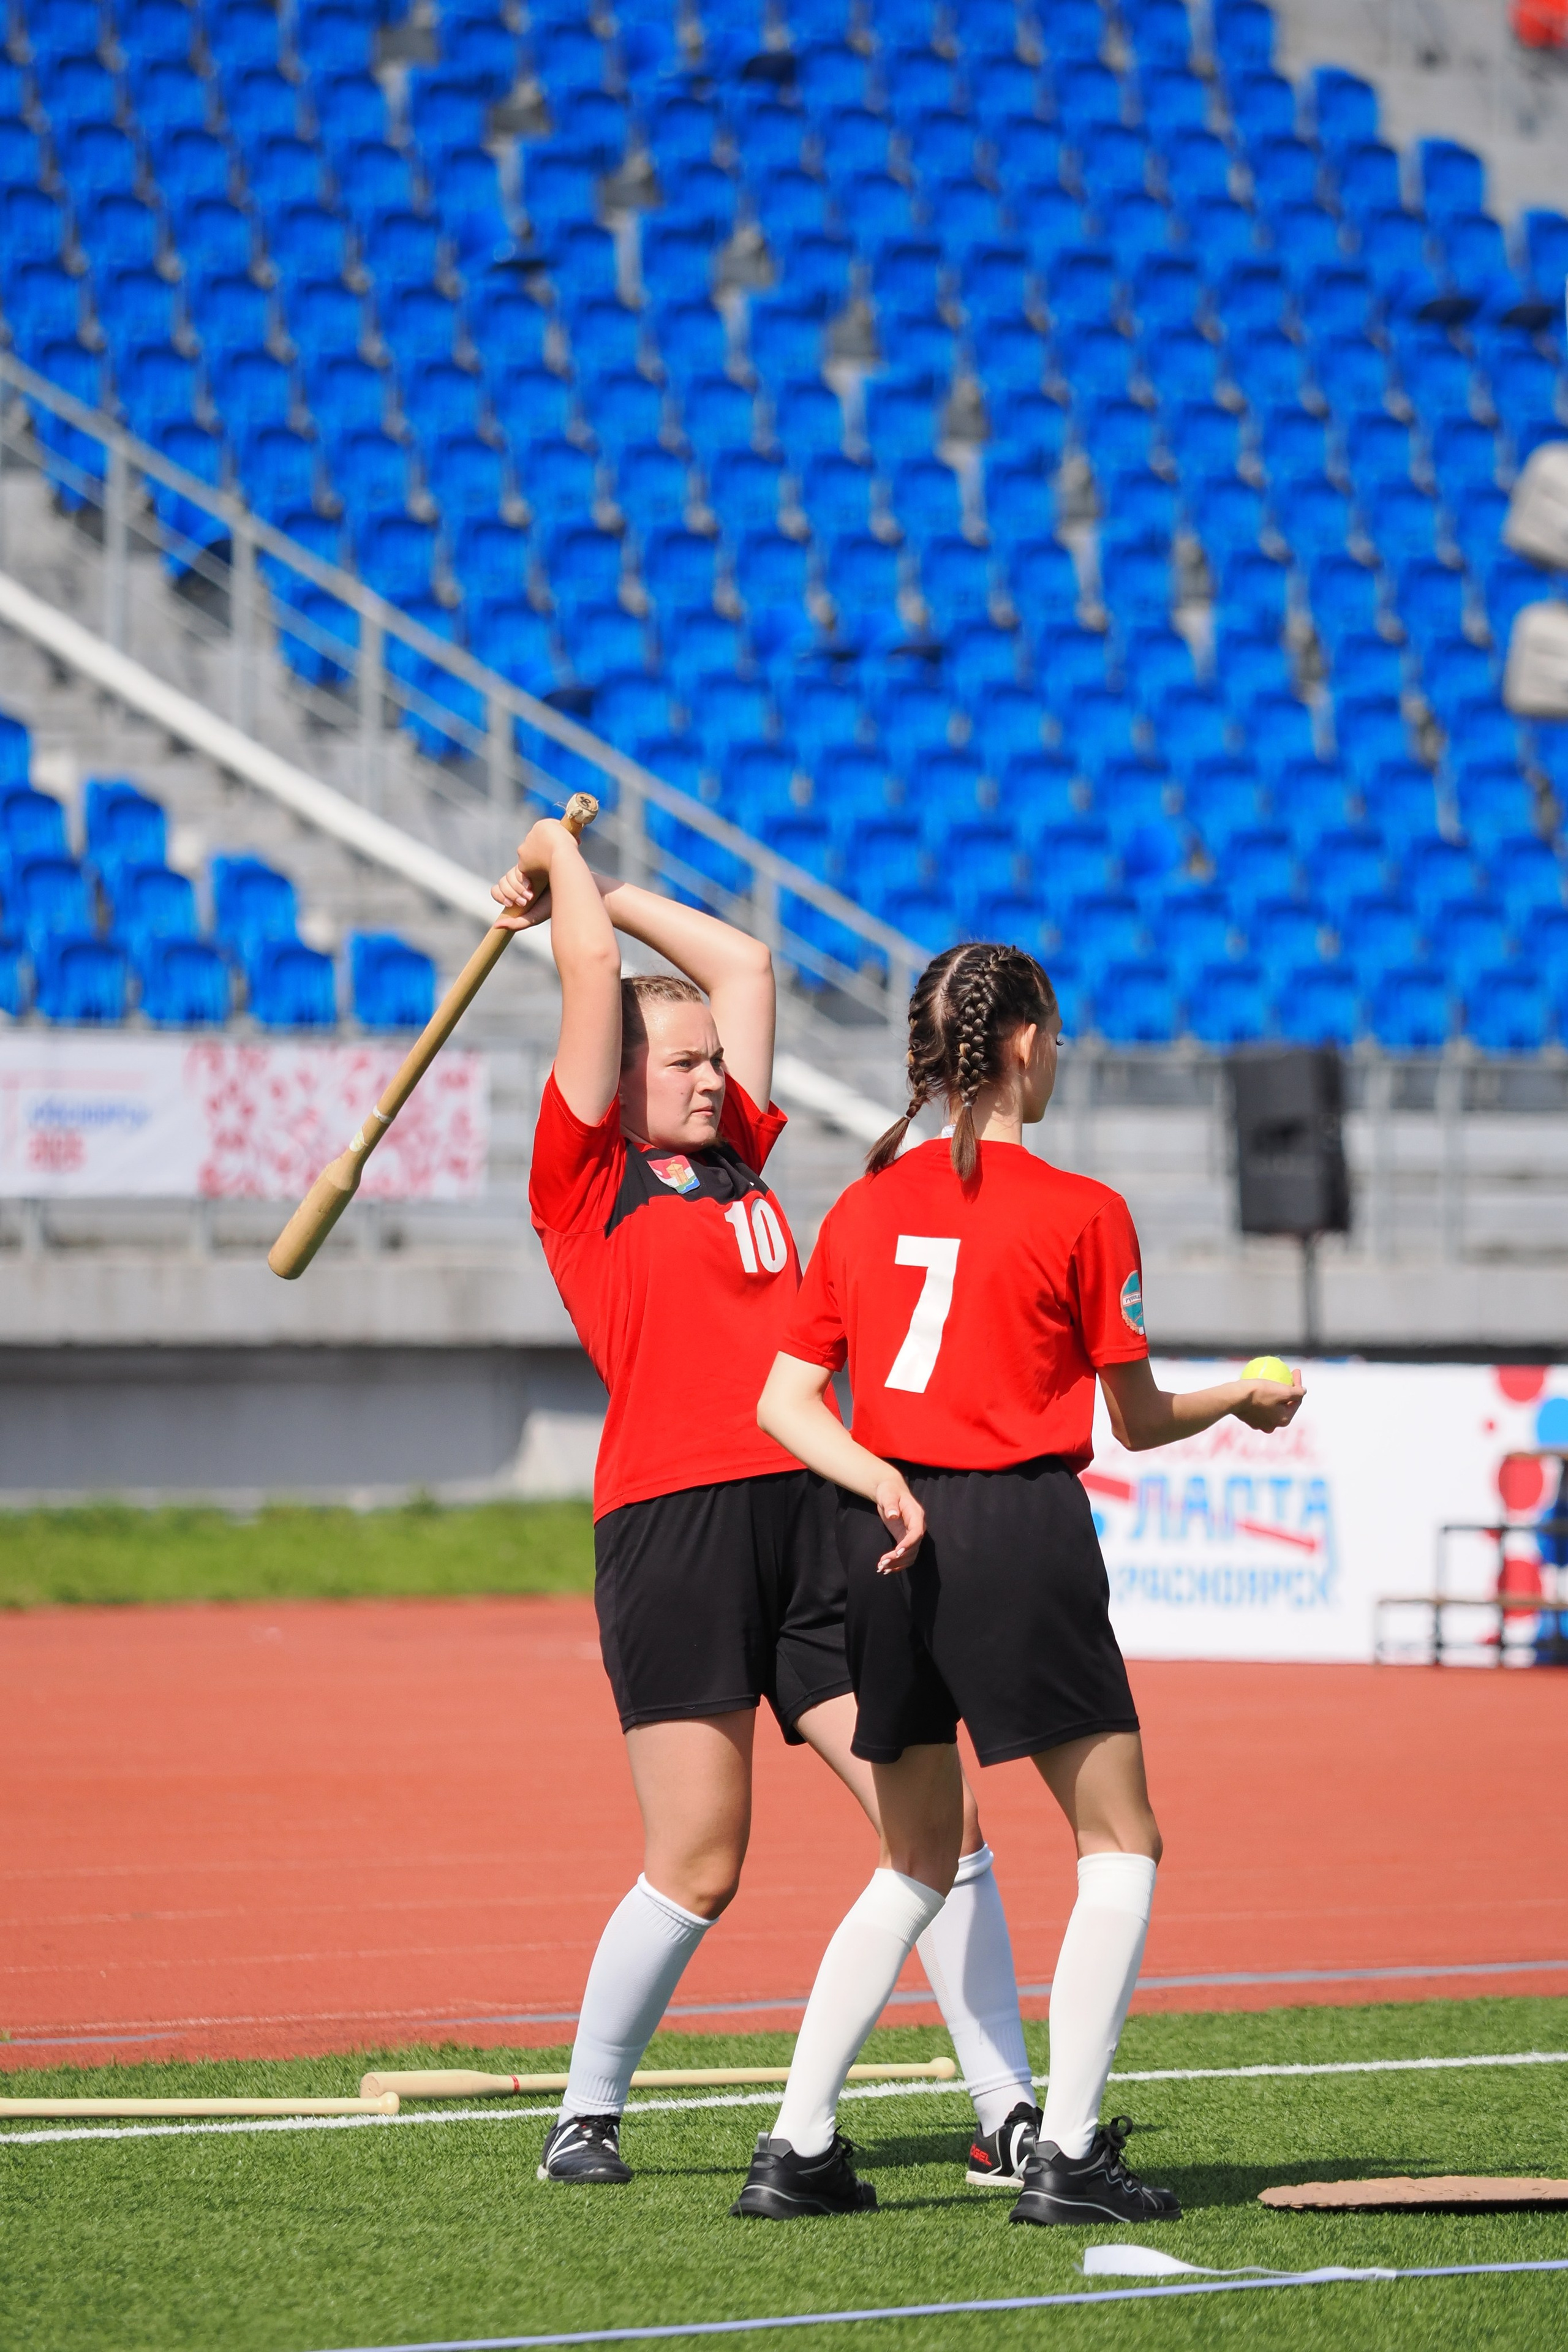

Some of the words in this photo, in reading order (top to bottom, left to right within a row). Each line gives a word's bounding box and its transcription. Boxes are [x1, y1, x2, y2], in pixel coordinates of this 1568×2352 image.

[724, 1198, 787, 1273] 10
[884, 1234, 961, 1393] 7
[1131, 1475, 1338, 1548] ЛАПТА
[1106, 1564, 1332, 1608] РАСНОЯРСК
